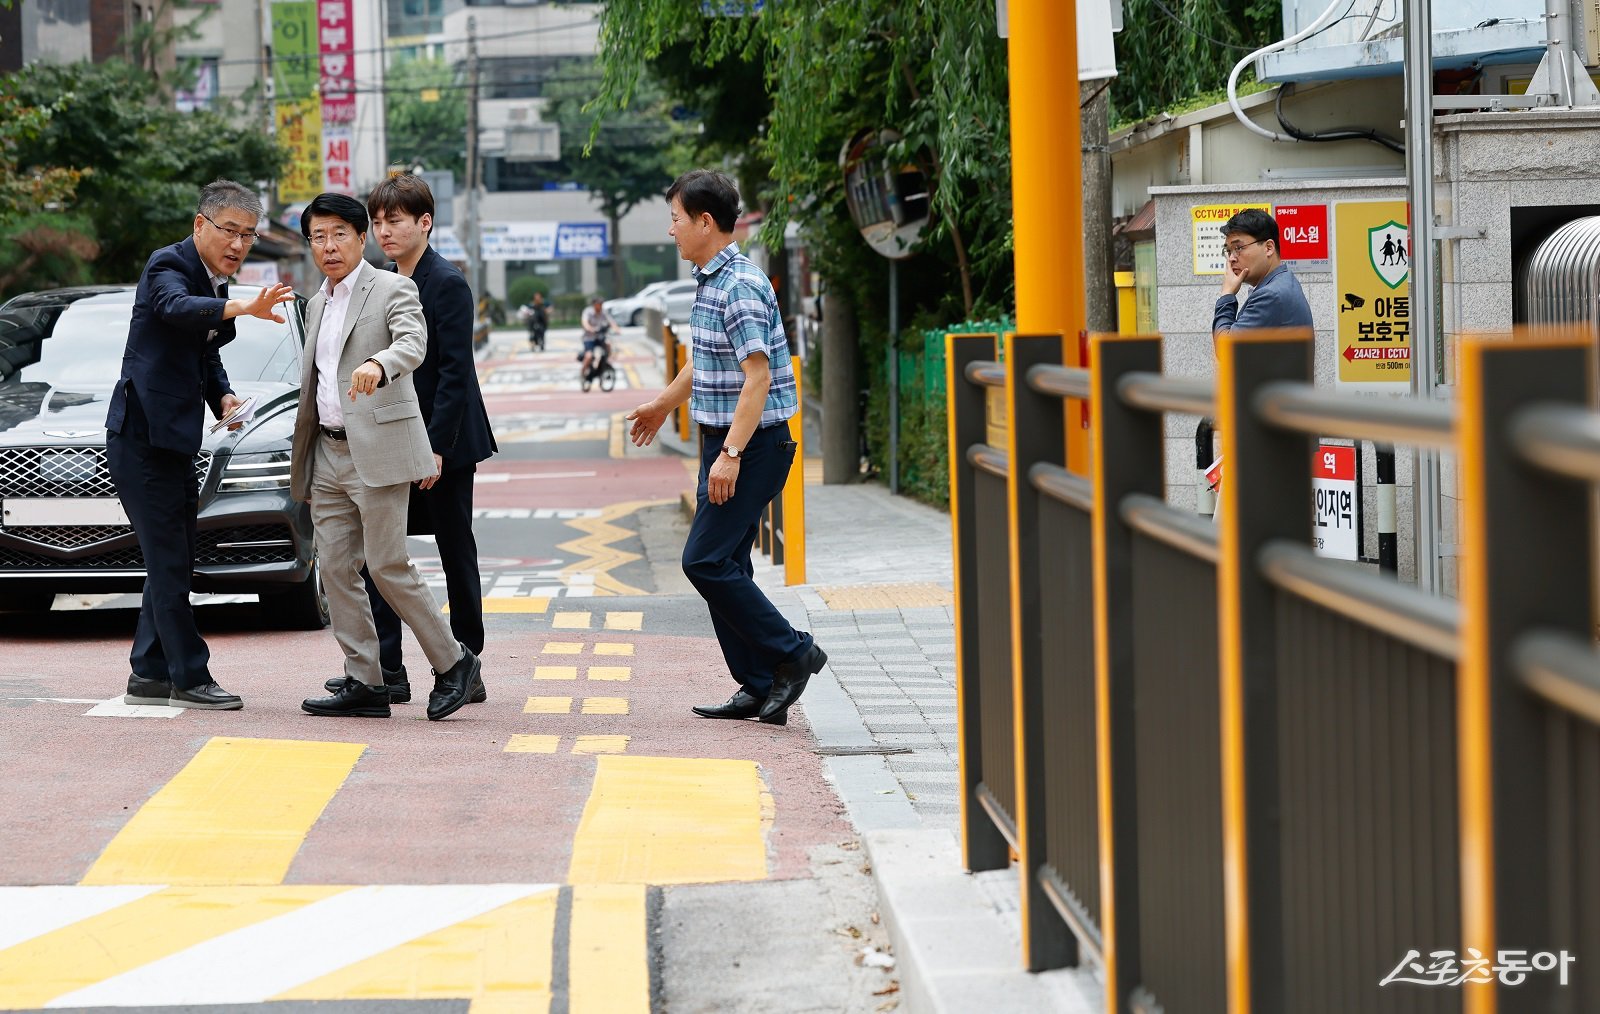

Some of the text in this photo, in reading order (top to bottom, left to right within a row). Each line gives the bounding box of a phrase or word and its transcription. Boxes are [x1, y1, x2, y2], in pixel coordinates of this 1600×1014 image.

[326, 140, 350, 188] 세탁
[1195, 209, 1231, 219] CCTV설치
[1283, 225, 1319, 244] 에스원
[1374, 296, 1409, 318] 아동
[1353, 348, 1409, 359] 24시간 CCTV
[1386, 361, 1404, 370] 500m
[1323, 452, 1336, 475] 역
